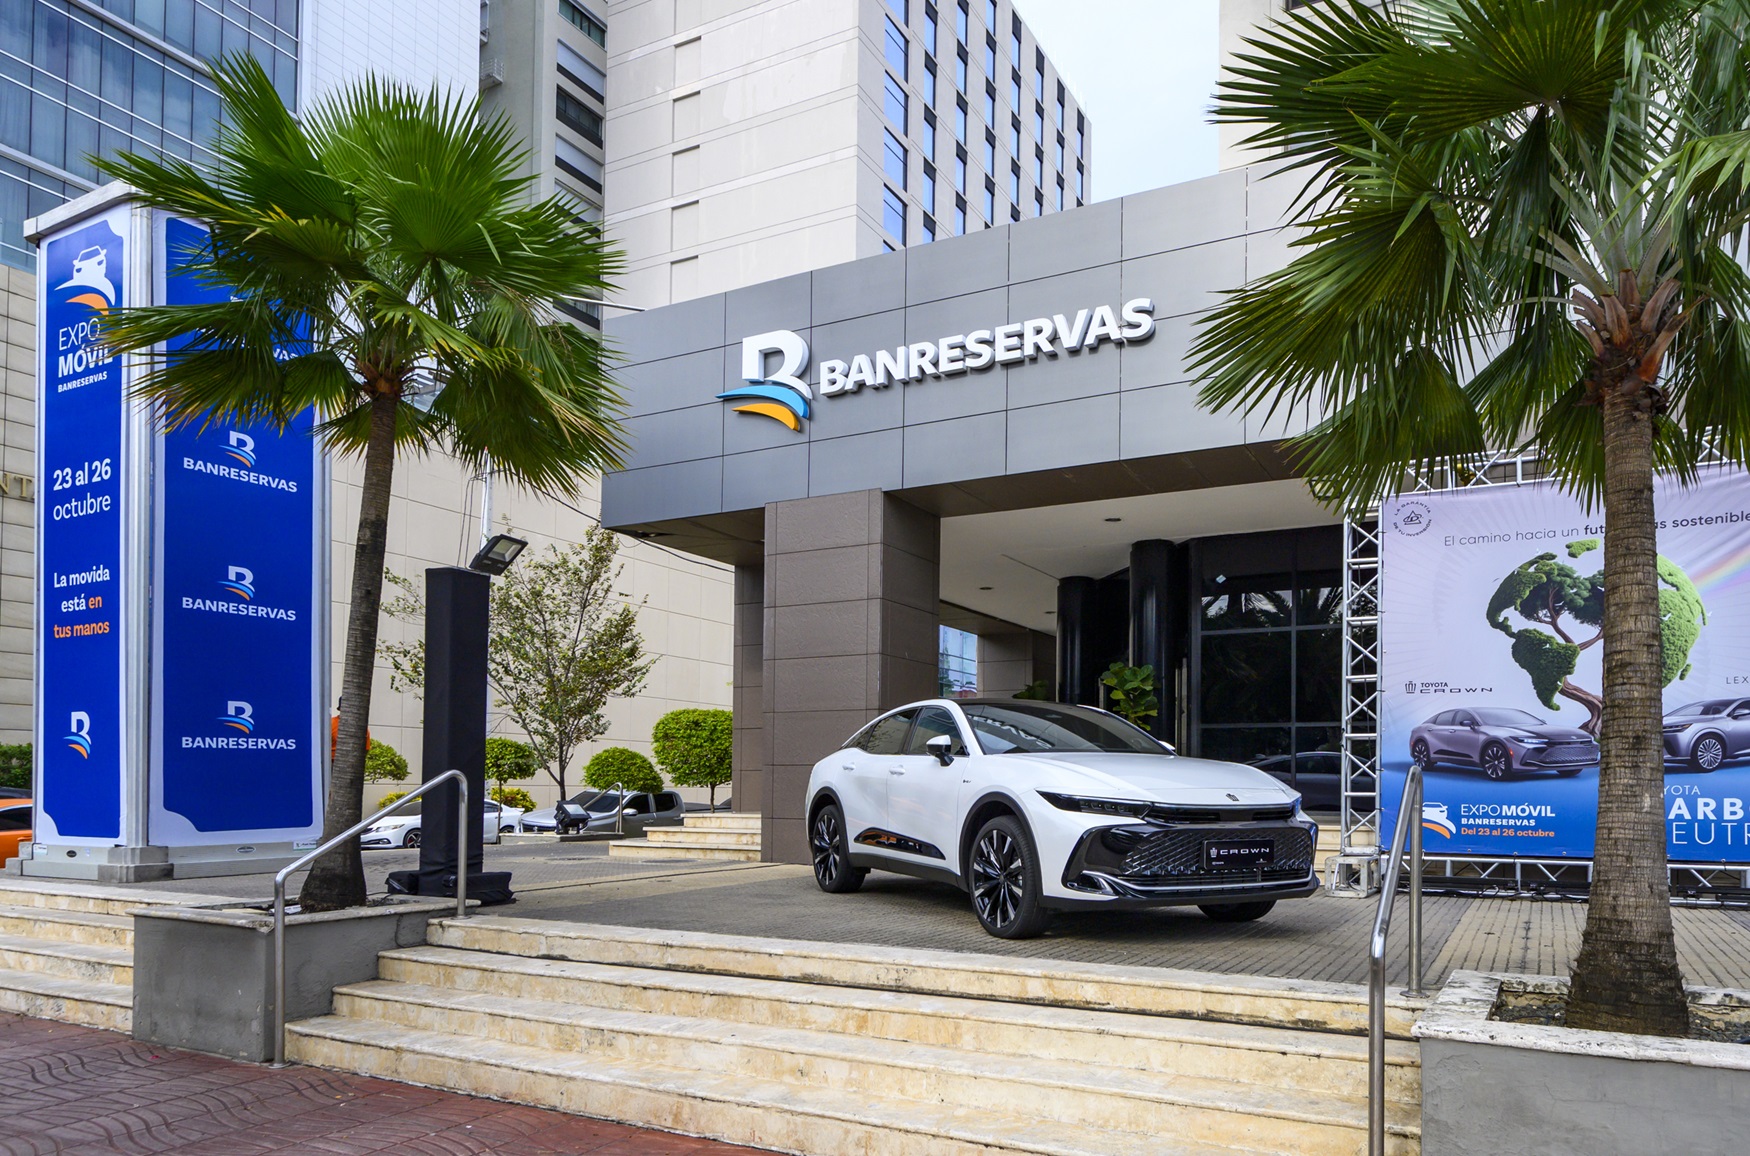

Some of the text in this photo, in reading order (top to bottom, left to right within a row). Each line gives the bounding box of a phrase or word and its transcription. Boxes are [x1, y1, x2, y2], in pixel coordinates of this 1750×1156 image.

[59, 317, 101, 351] EXPO
[819, 297, 1155, 397] BANRESERVAS
[58, 343, 113, 378] MÓVIL
[57, 370, 108, 393] BANRESERVAS
[53, 457, 112, 491] 23 al 26
[183, 457, 298, 492] BANRESERVAS
[53, 492, 112, 521] octubre
[1444, 524, 1605, 547] El camino hacia un fut
[53, 564, 111, 588] La movida
[61, 594, 103, 613] está en
[182, 597, 297, 622] BANRESERVAS
[53, 621, 110, 639] tus manos
[181, 736, 297, 751] BANRESERVAS
[1664, 785, 1701, 796] YOTA
[1667, 797, 1750, 820] ARB
[1461, 818, 1536, 827] BANRESERVAS
[1461, 827, 1555, 837] Del 23 al 26 octubre
[1672, 821, 1750, 845] EUT
[1220, 847, 1270, 855] CROWN
